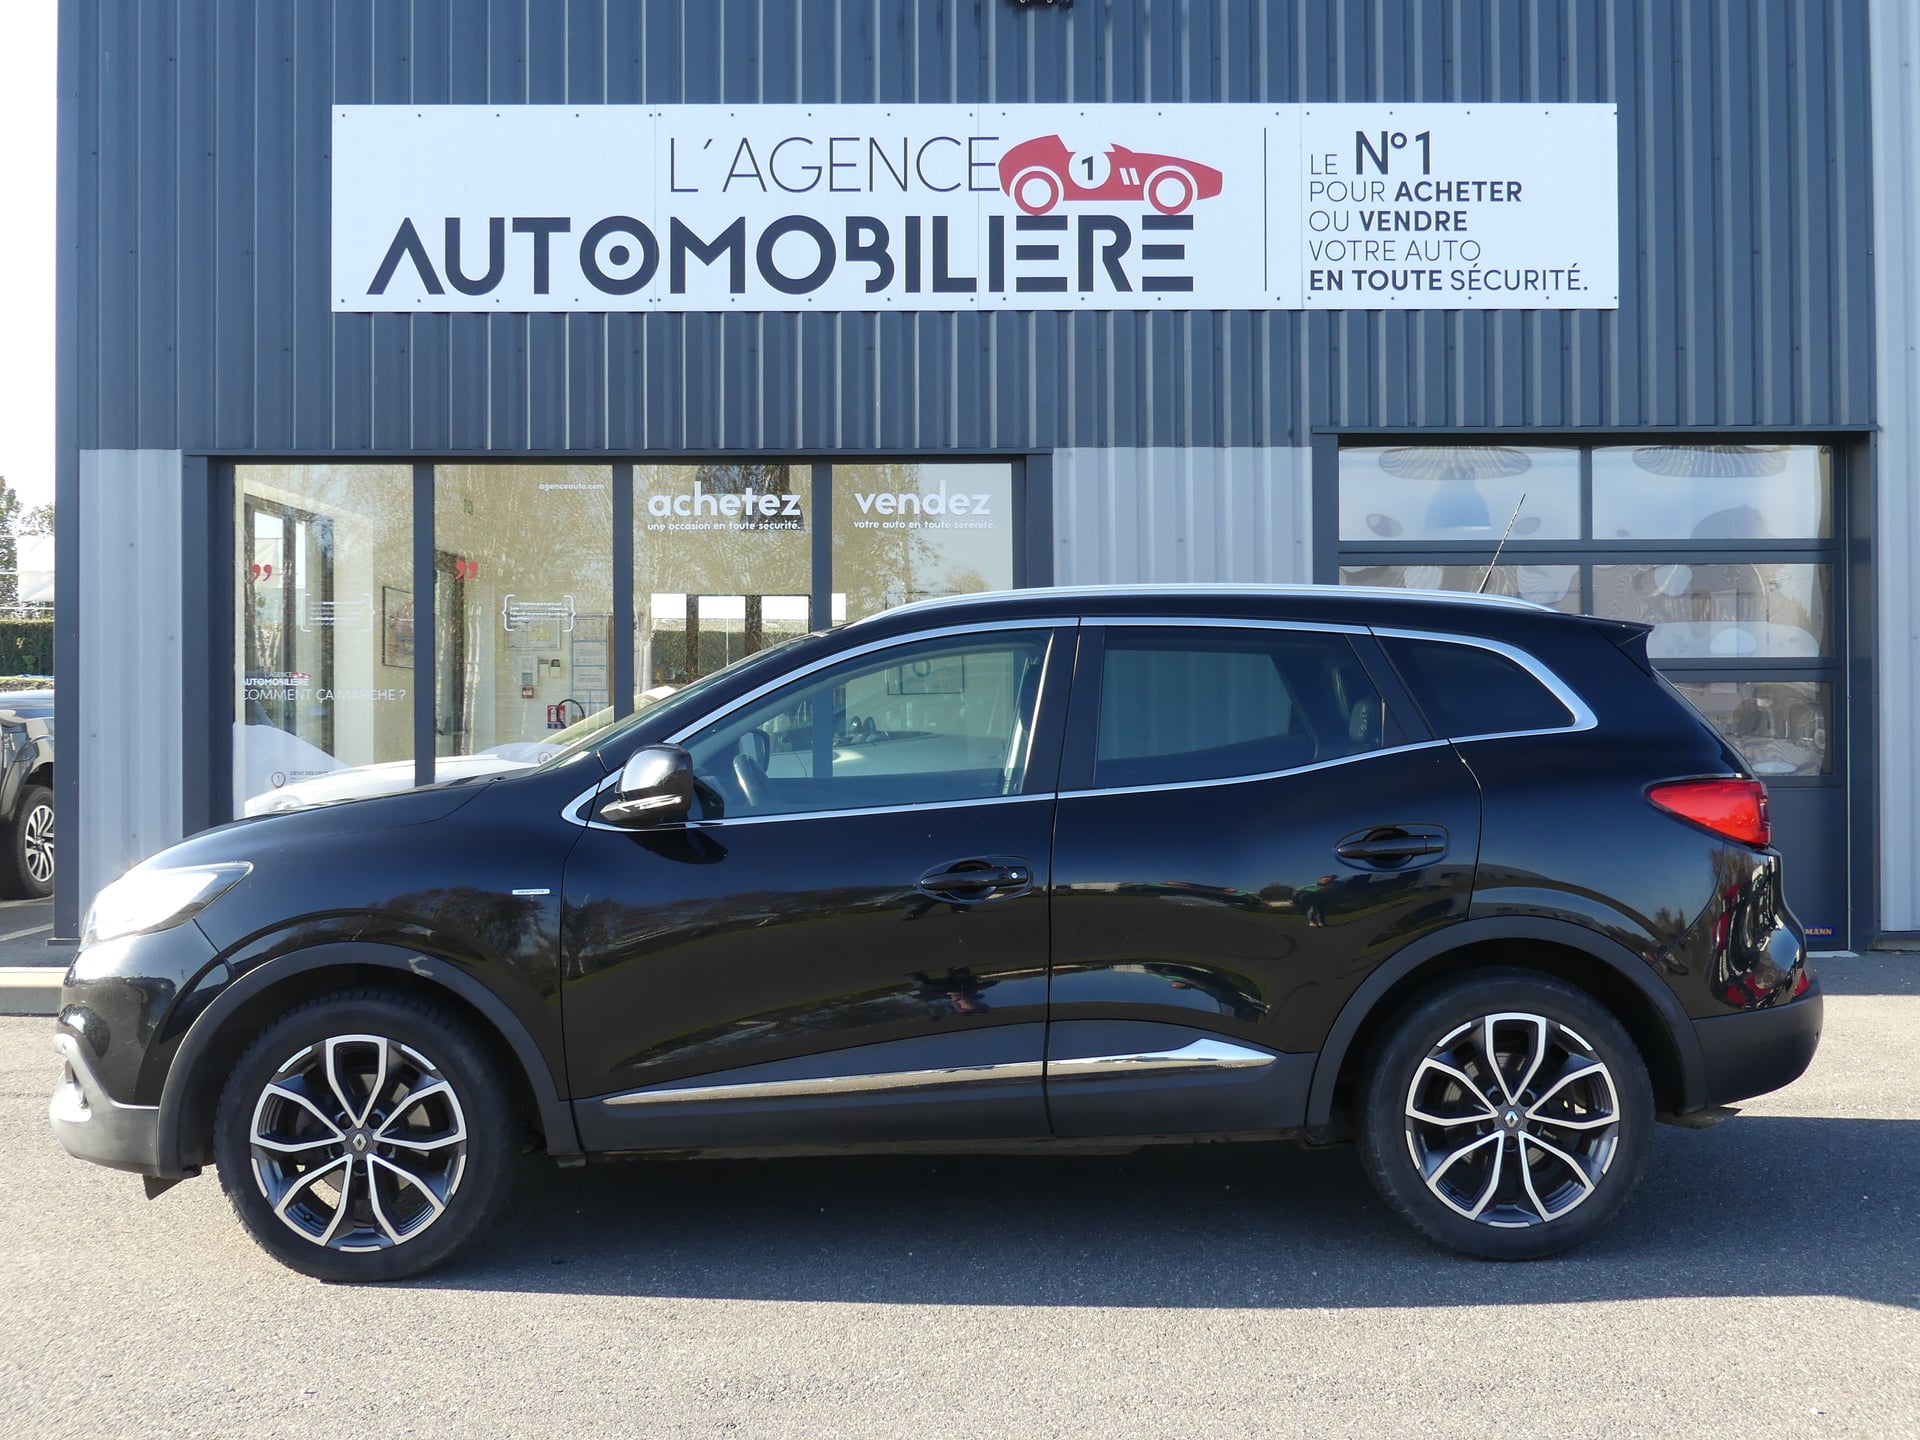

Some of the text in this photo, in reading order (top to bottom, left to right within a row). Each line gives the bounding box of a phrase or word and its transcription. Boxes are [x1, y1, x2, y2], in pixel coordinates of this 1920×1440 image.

[1081, 155, 1094, 181] 1
[1310, 153, 1338, 175] LE
[1310, 180, 1522, 203] POUR ACHETER
[1308, 210, 1468, 232] OU VENDRE
[1308, 239, 1481, 262] VOTRE AUTO
[1309, 262, 1589, 292] EN TOUTE SÉCURITÉ.
[539, 483, 605, 492] agenceauto.com
[647, 480, 802, 517] achetez
[854, 479, 993, 516] vendez
[647, 519, 801, 531] une occasion en toute sécurité.
[853, 520, 880, 529] votre
[882, 520, 906, 529] auto
[924, 520, 951, 529] toute
[240, 688, 313, 701] COMMENT
[316, 688, 335, 704] ÇA
